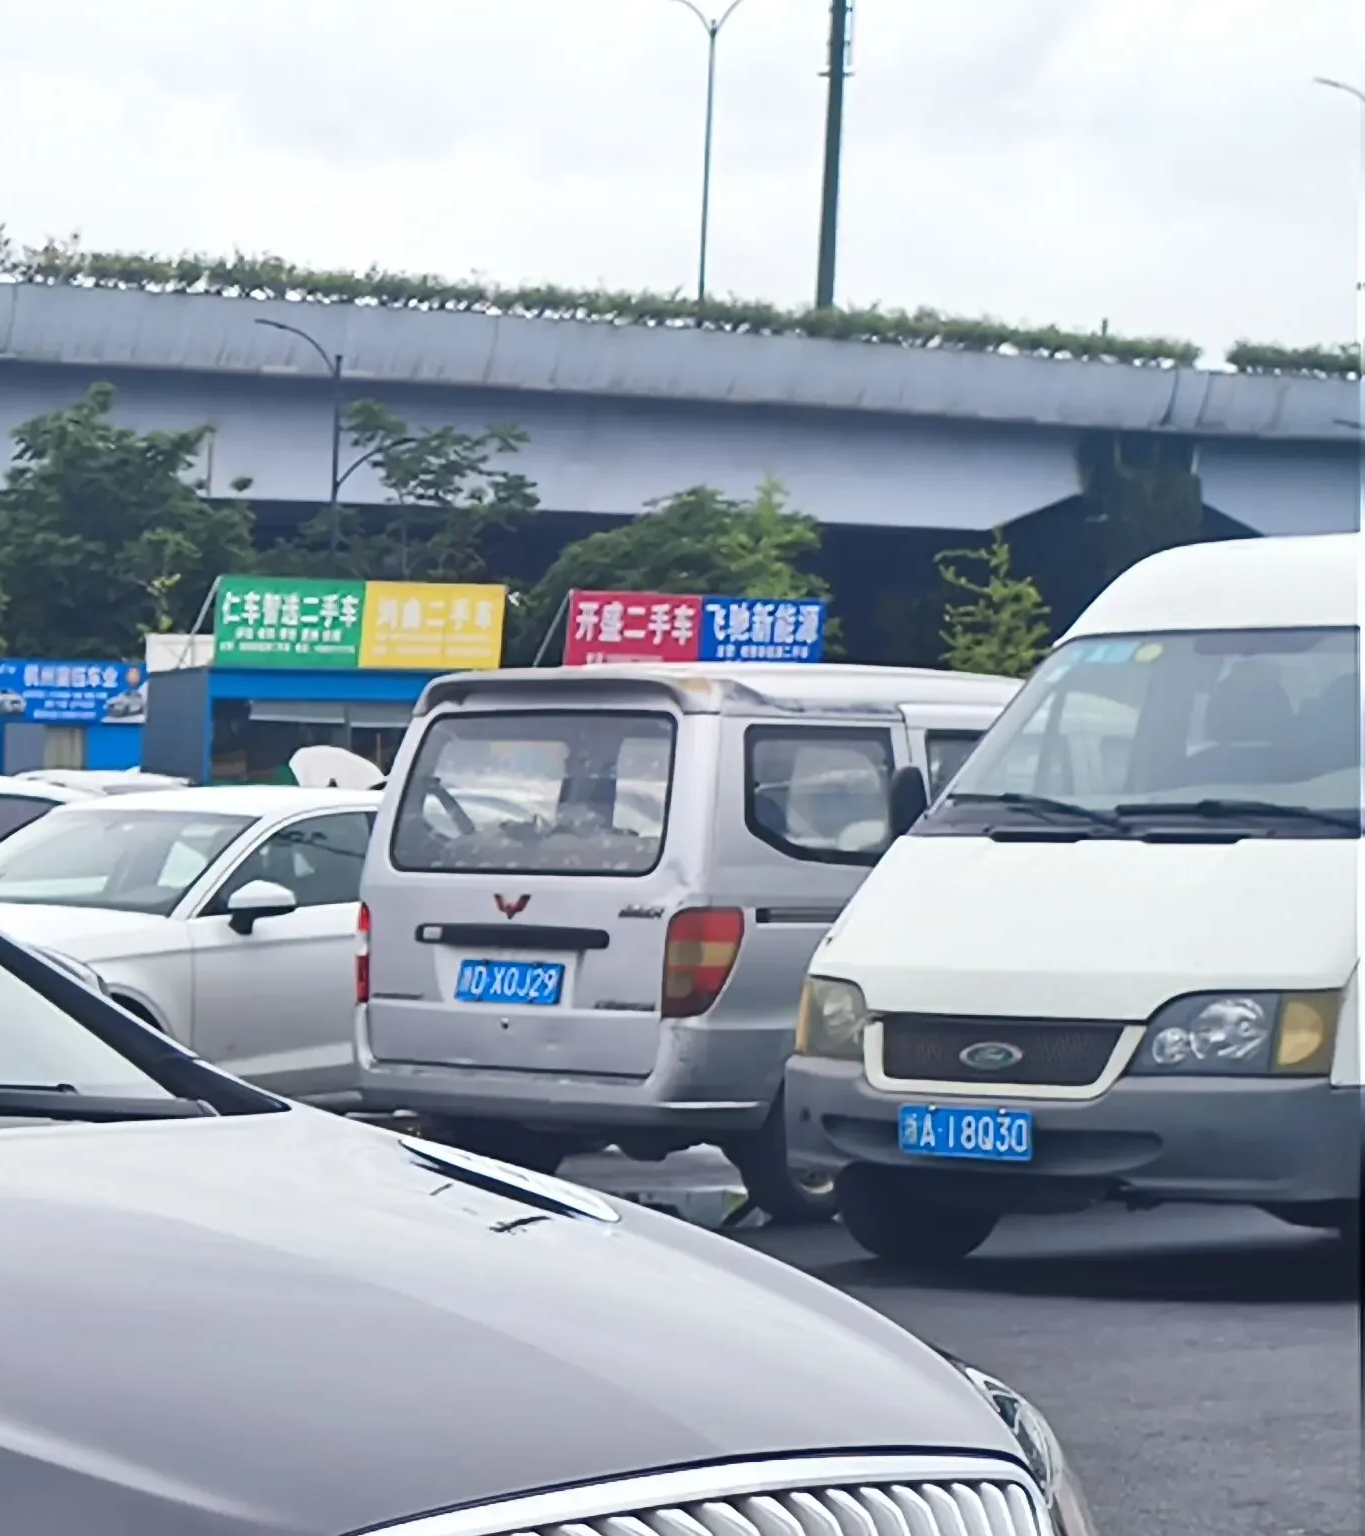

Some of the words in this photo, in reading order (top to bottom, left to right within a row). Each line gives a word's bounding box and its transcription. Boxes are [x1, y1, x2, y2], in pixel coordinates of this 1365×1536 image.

[575, 601, 696, 646] 开盛二手车
[705, 602, 822, 644] 飞驰新能源
[23, 664, 118, 688] 杭州车业
